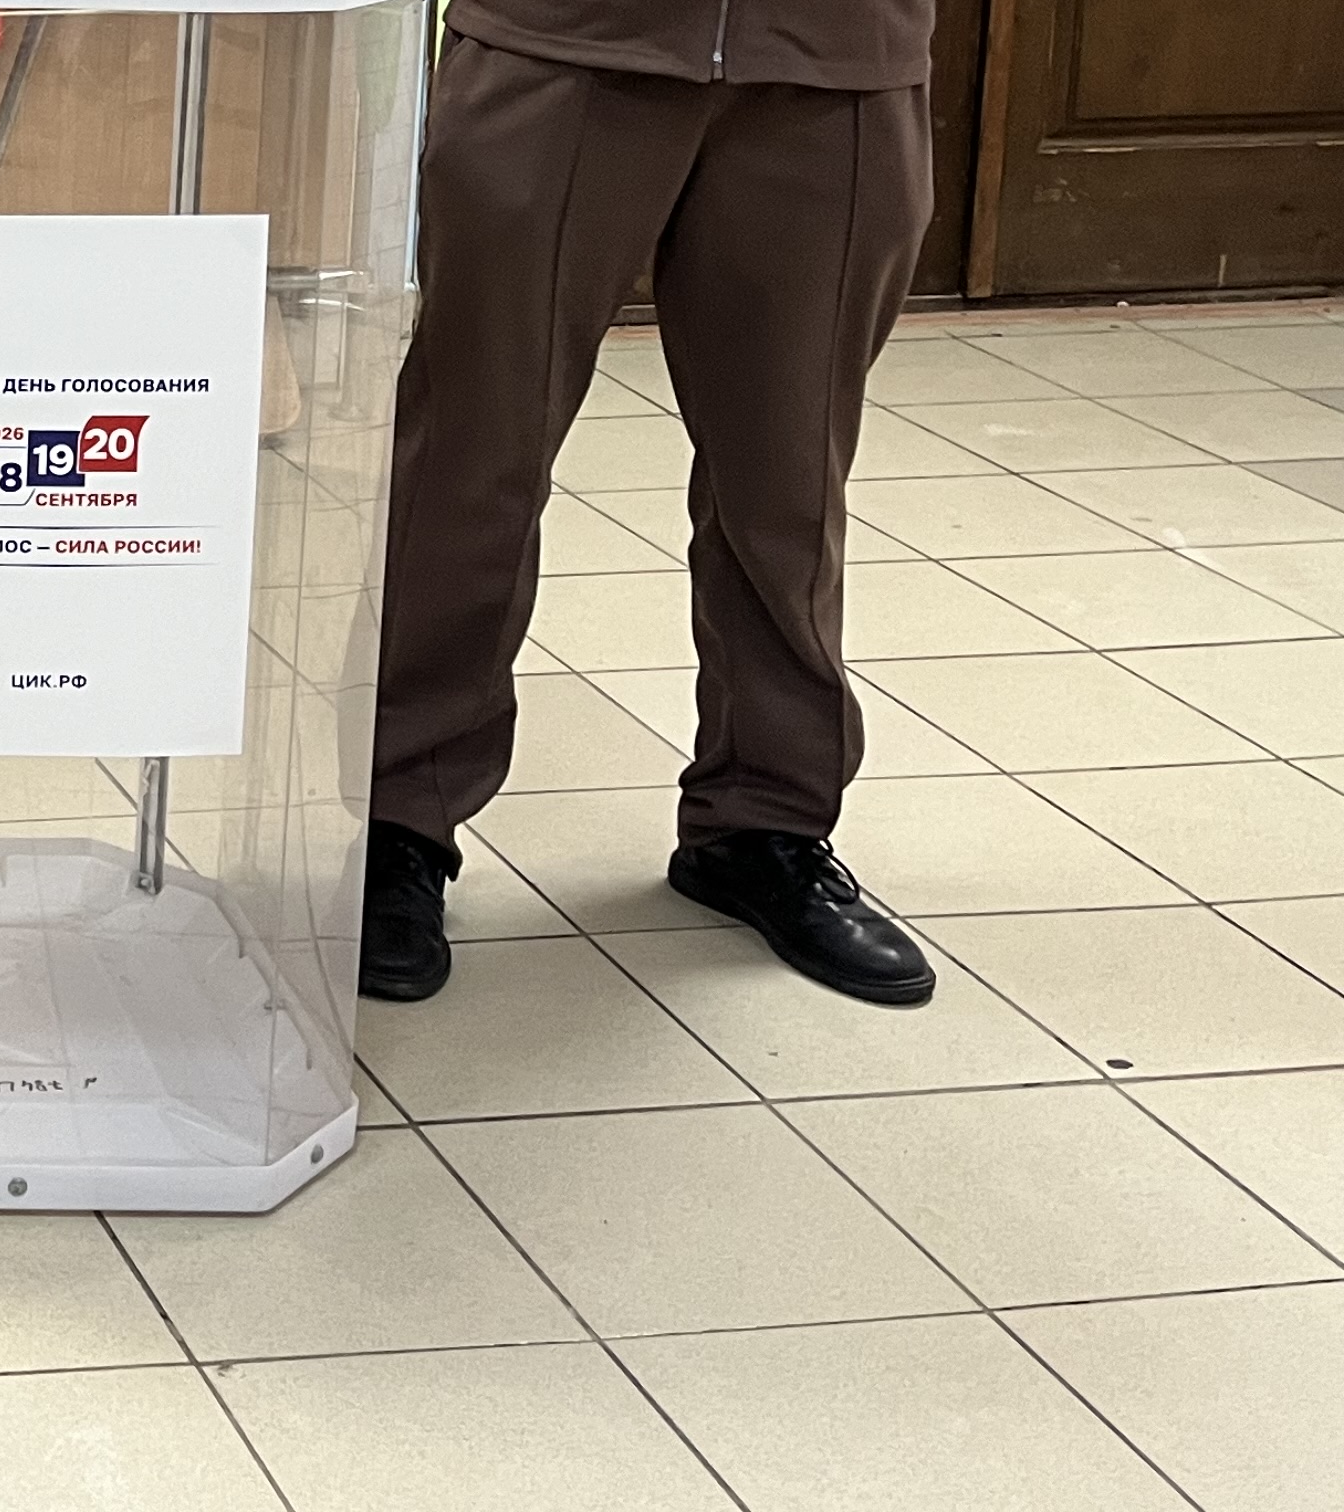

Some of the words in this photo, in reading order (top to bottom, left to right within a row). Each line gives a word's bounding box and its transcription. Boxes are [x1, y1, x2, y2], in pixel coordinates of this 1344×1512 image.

[2, 377, 56, 395] ДЕНЬ
[61, 376, 210, 394] ГОЛОСОВАНИЯ
[33, 443, 76, 476] 19
[83, 428, 135, 460] 20
[35, 493, 138, 508] СЕНТЯБРЯ
[55, 539, 110, 555] СИЛА
[114, 539, 202, 555] РОССИИ!
[11, 673, 88, 691] ЦИК.РФ
